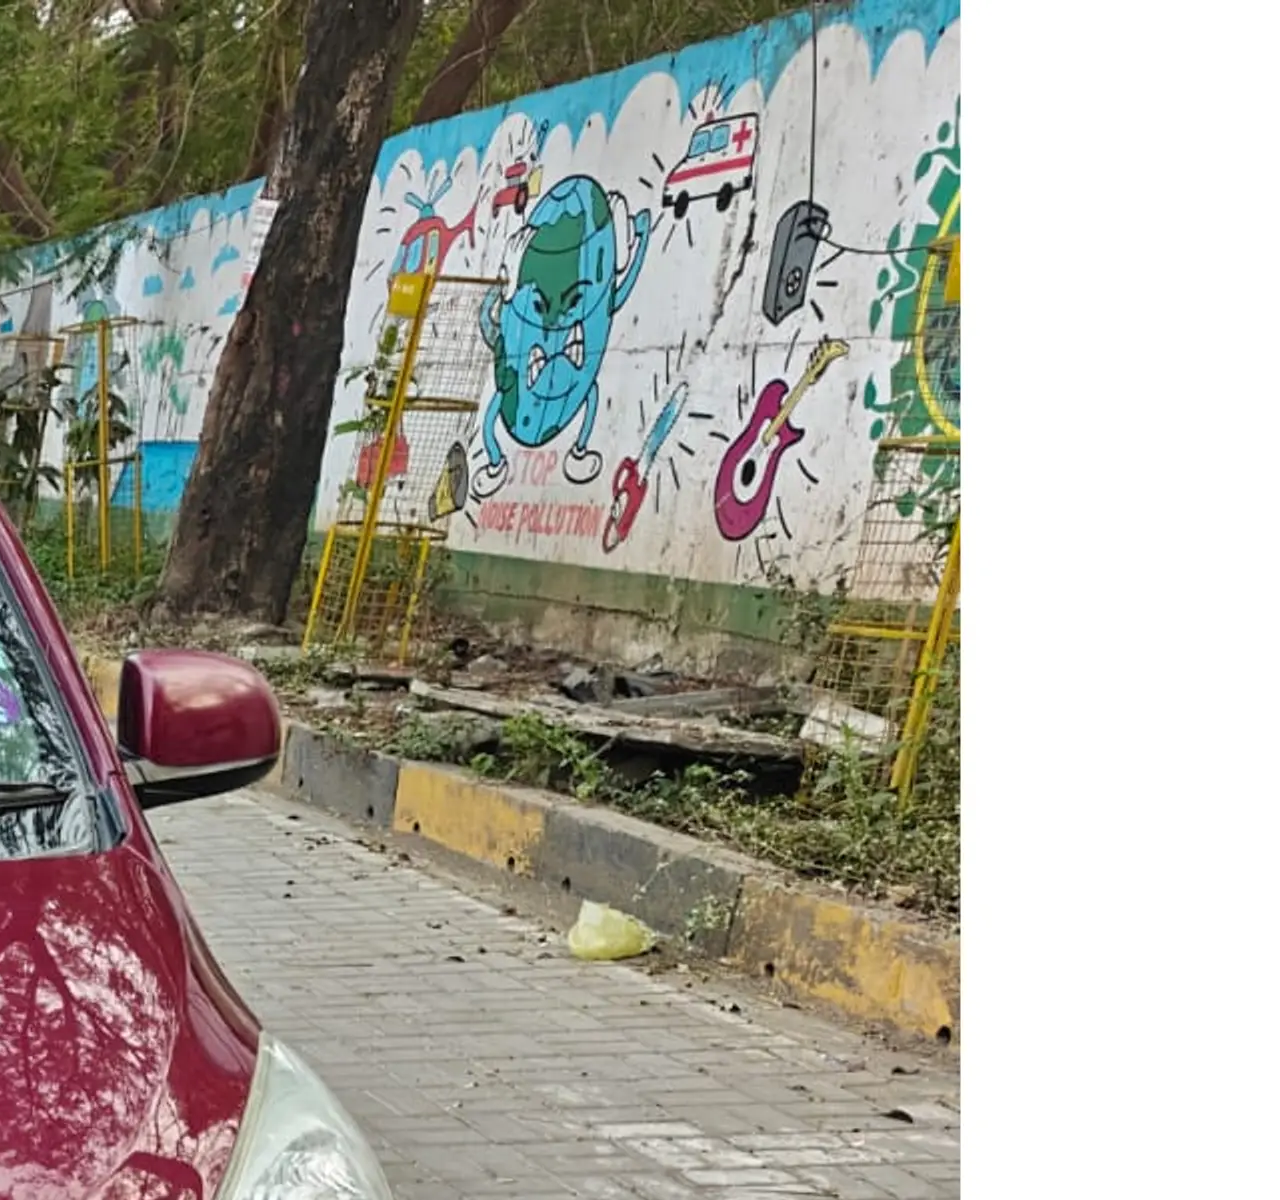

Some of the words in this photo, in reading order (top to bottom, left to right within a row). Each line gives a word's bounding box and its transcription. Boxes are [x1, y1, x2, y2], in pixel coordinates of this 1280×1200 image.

[508, 449, 558, 486] STOP
[480, 501, 518, 532] NOISE
[517, 502, 604, 537] POLLUTION
